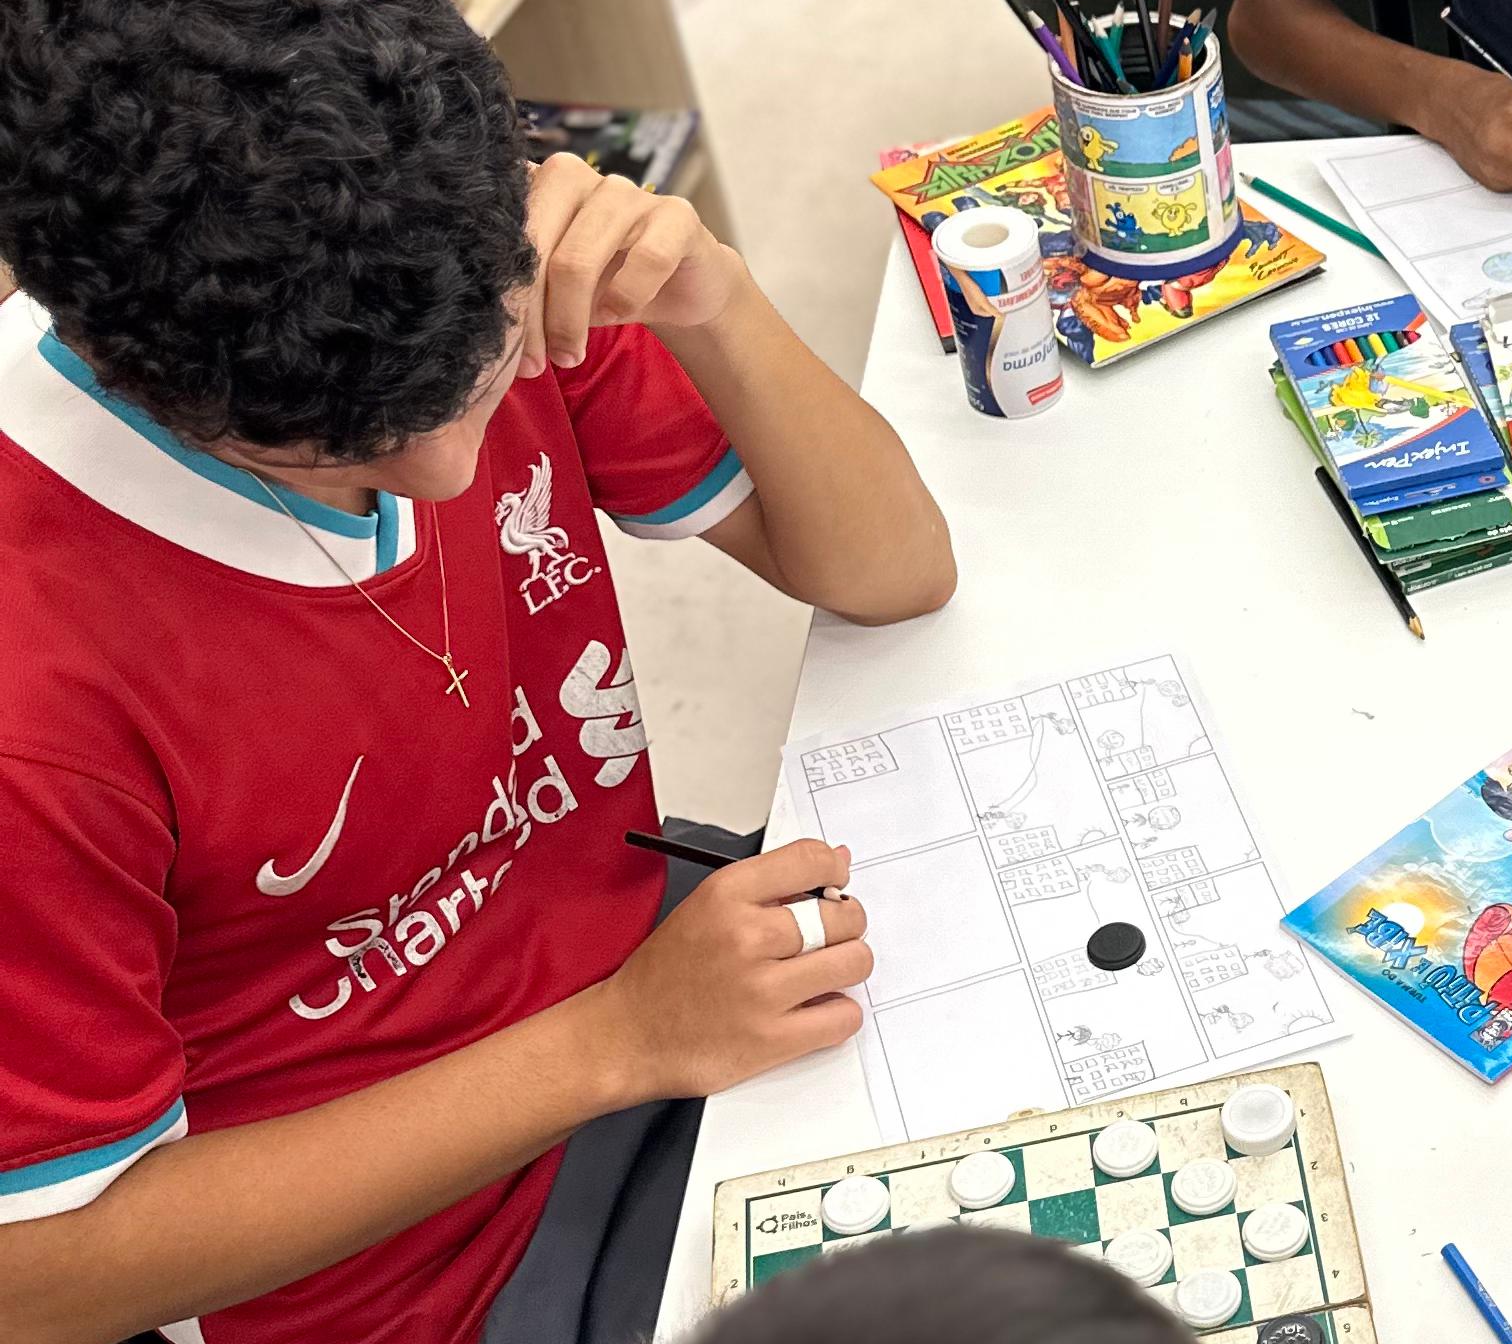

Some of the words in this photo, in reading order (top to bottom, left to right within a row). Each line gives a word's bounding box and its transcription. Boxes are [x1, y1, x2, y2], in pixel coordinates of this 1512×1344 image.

[1322, 317, 1364, 333] CORES
[1365, 312, 1381, 324] 12
[1363, 440, 1471, 470] InjexPen
[1381, 969, 1397, 981] DO
[1397, 981, 1428, 1003] TURMA
[780, 1217, 818, 1232] Filhos
